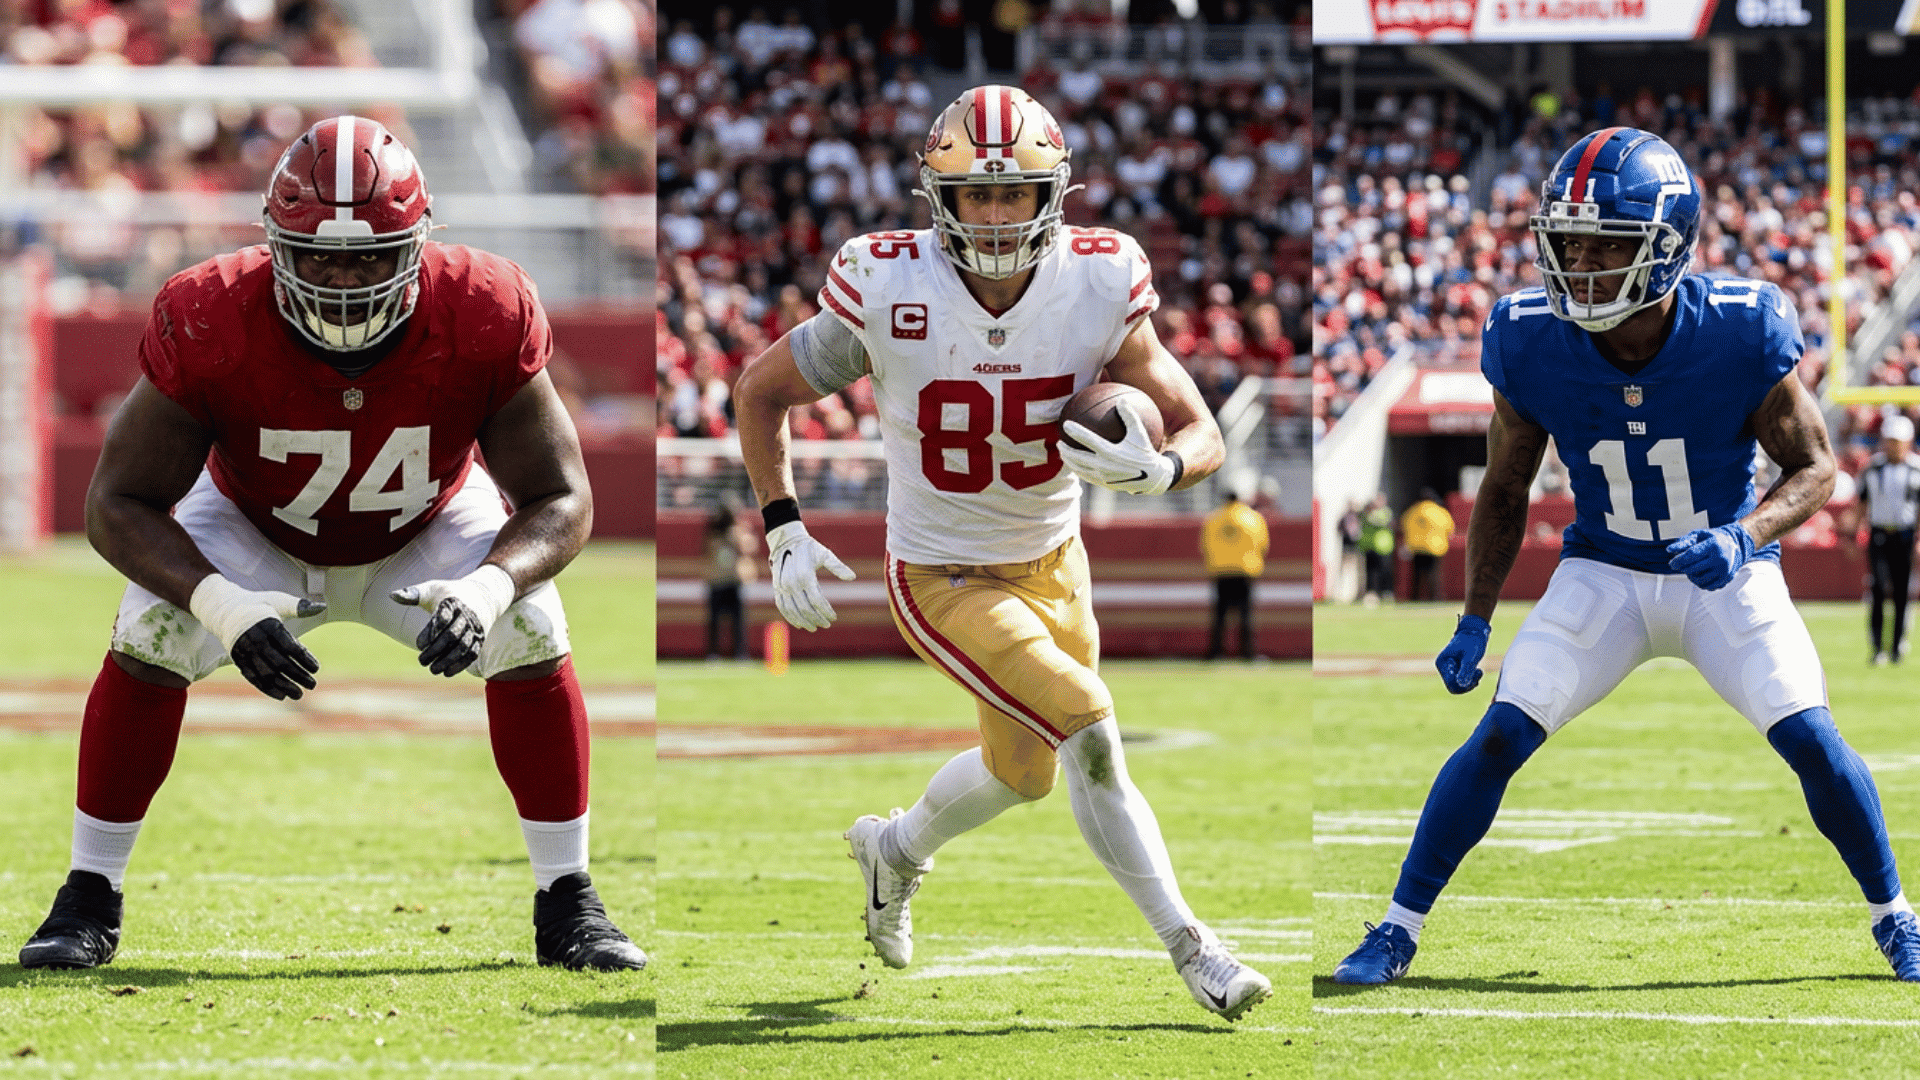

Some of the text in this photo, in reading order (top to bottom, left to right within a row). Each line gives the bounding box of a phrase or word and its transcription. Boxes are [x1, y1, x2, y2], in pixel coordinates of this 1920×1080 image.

[259, 425, 440, 536] 74
[917, 374, 1075, 493] 85
[1588, 438, 1710, 541] 11
